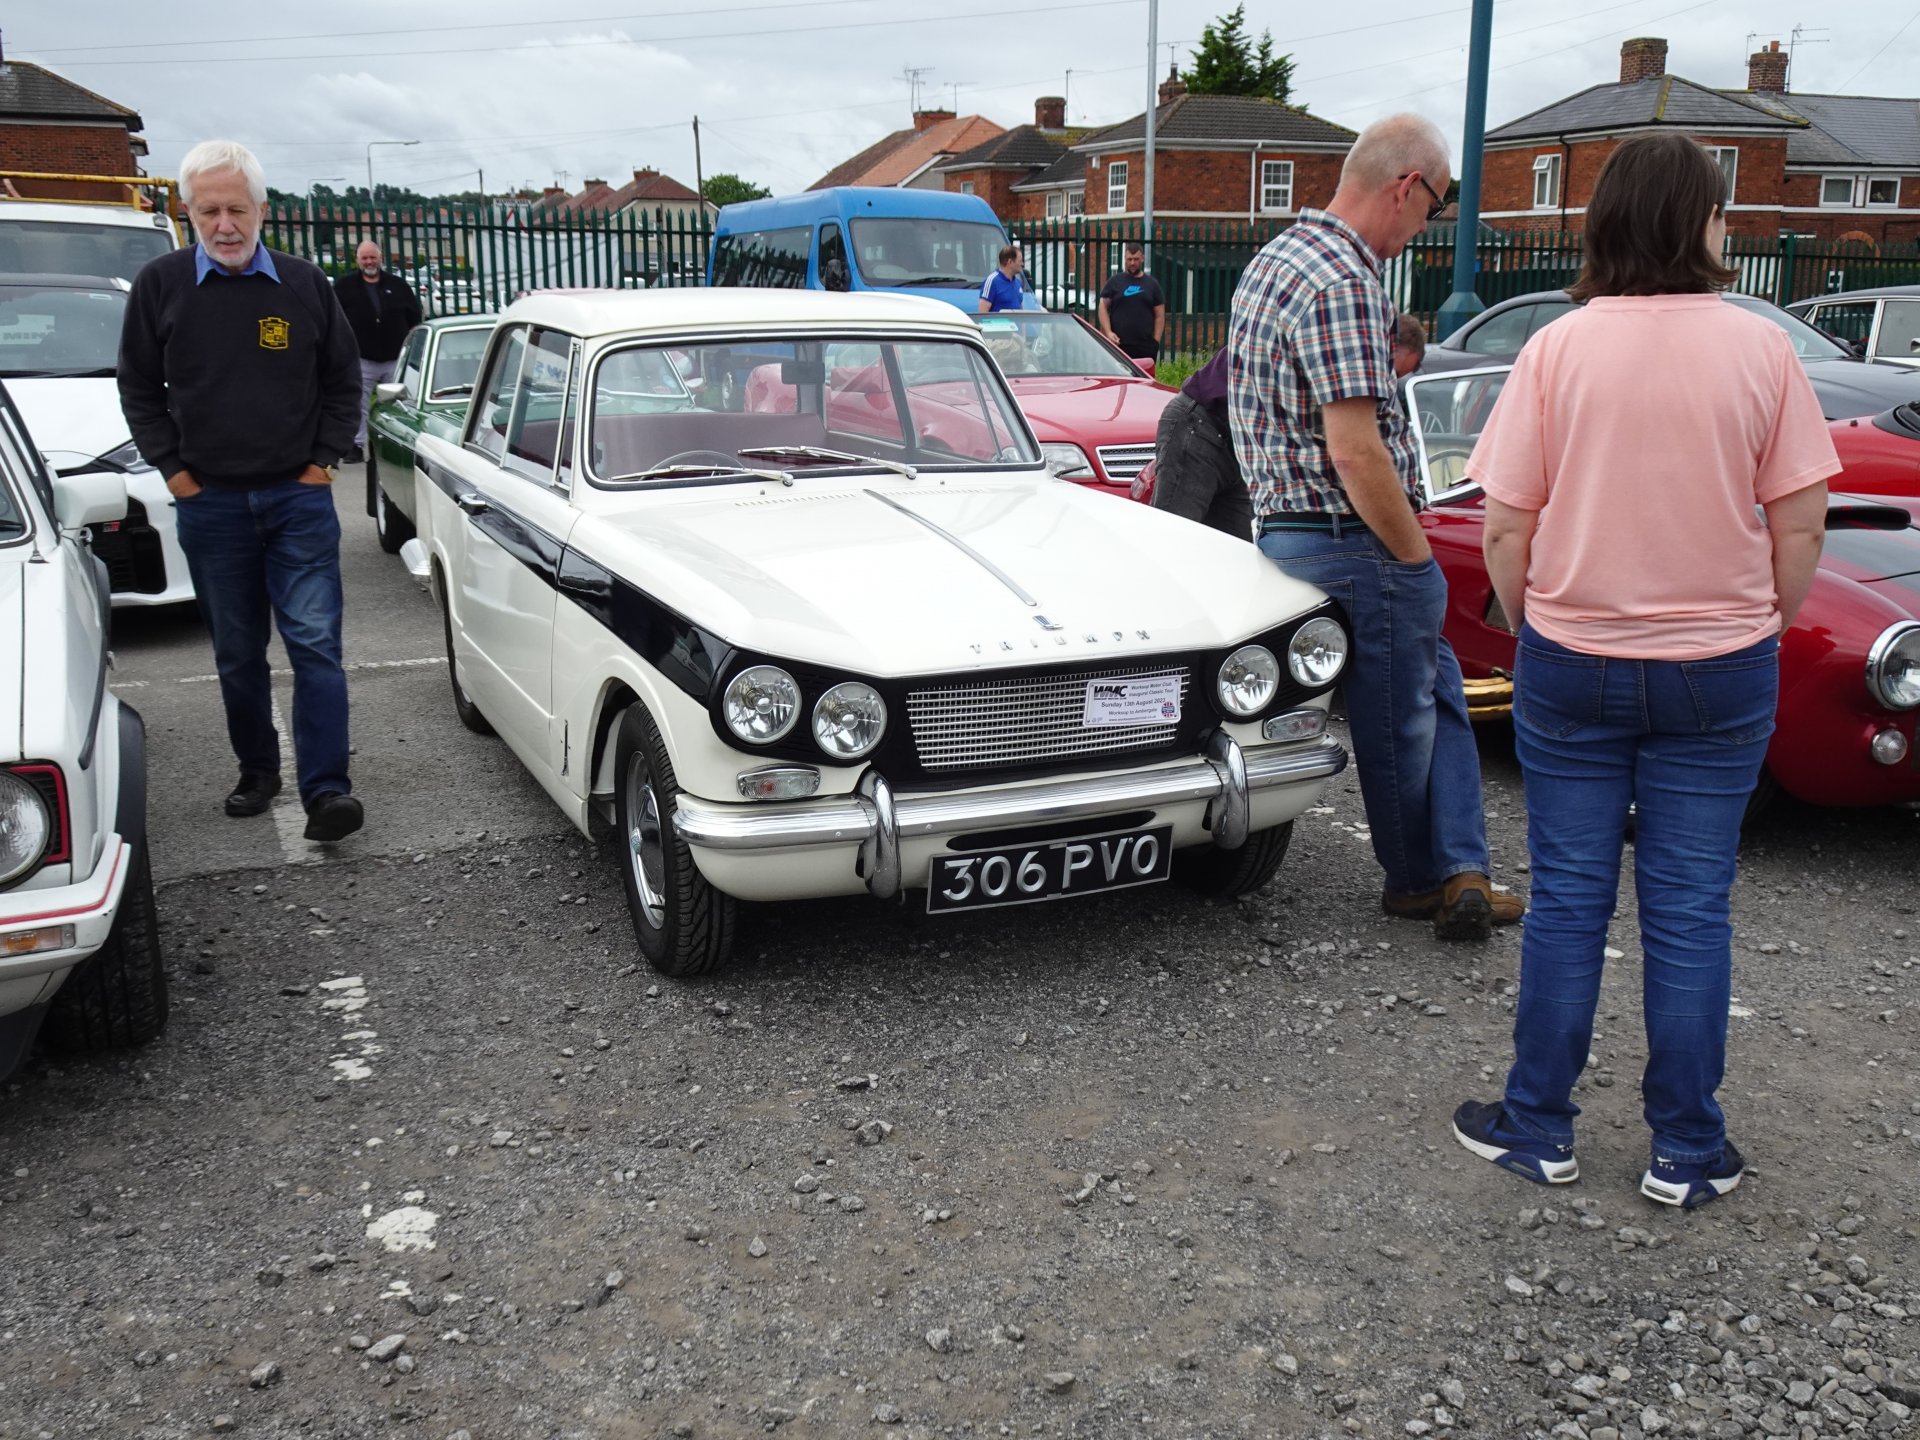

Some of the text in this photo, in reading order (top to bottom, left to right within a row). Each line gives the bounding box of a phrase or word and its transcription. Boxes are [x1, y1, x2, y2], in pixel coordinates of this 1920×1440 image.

[1094, 685, 1127, 698] WMC
[1129, 690, 1148, 698] Inaugural
[1136, 699, 1153, 707] August
[941, 832, 1159, 903] 306 PVO
